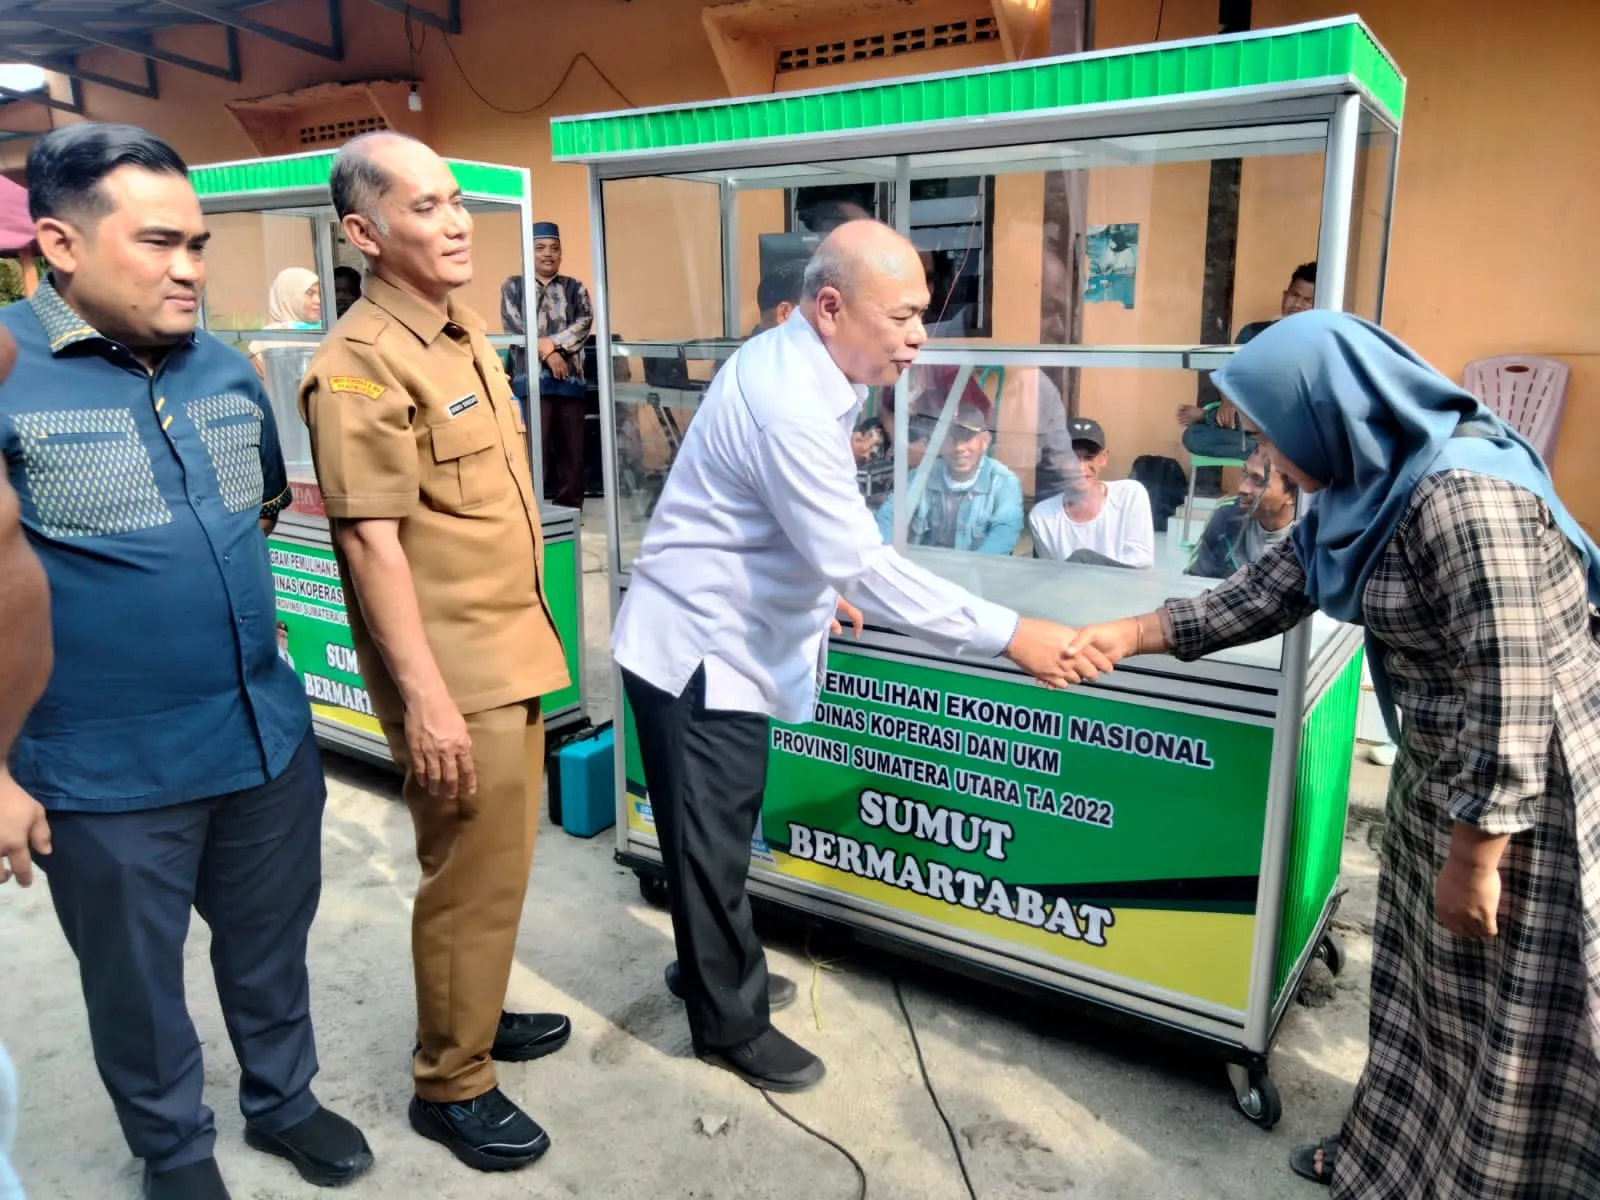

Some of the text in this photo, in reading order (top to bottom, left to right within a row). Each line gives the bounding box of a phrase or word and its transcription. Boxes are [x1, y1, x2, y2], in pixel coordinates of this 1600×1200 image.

[270, 549, 290, 566] GRAM
[290, 553, 331, 576] PEMULIHAN
[274, 574, 344, 604] INAS KOPERAS
[276, 597, 302, 614] ROVINSI
[326, 642, 360, 675] SUM
[303, 671, 374, 715] BERMART
[824, 671, 1213, 768] EMULIHAN EKONOMI NASIONAL
[814, 704, 1060, 775] DINAS KOPERASI DAN UKM
[772, 729, 1113, 828] PROVINSI SUMATERA UTARA T.A 2022
[859, 789, 1013, 861] SUMUT
[787, 821, 1115, 947] BERMARTABAT
